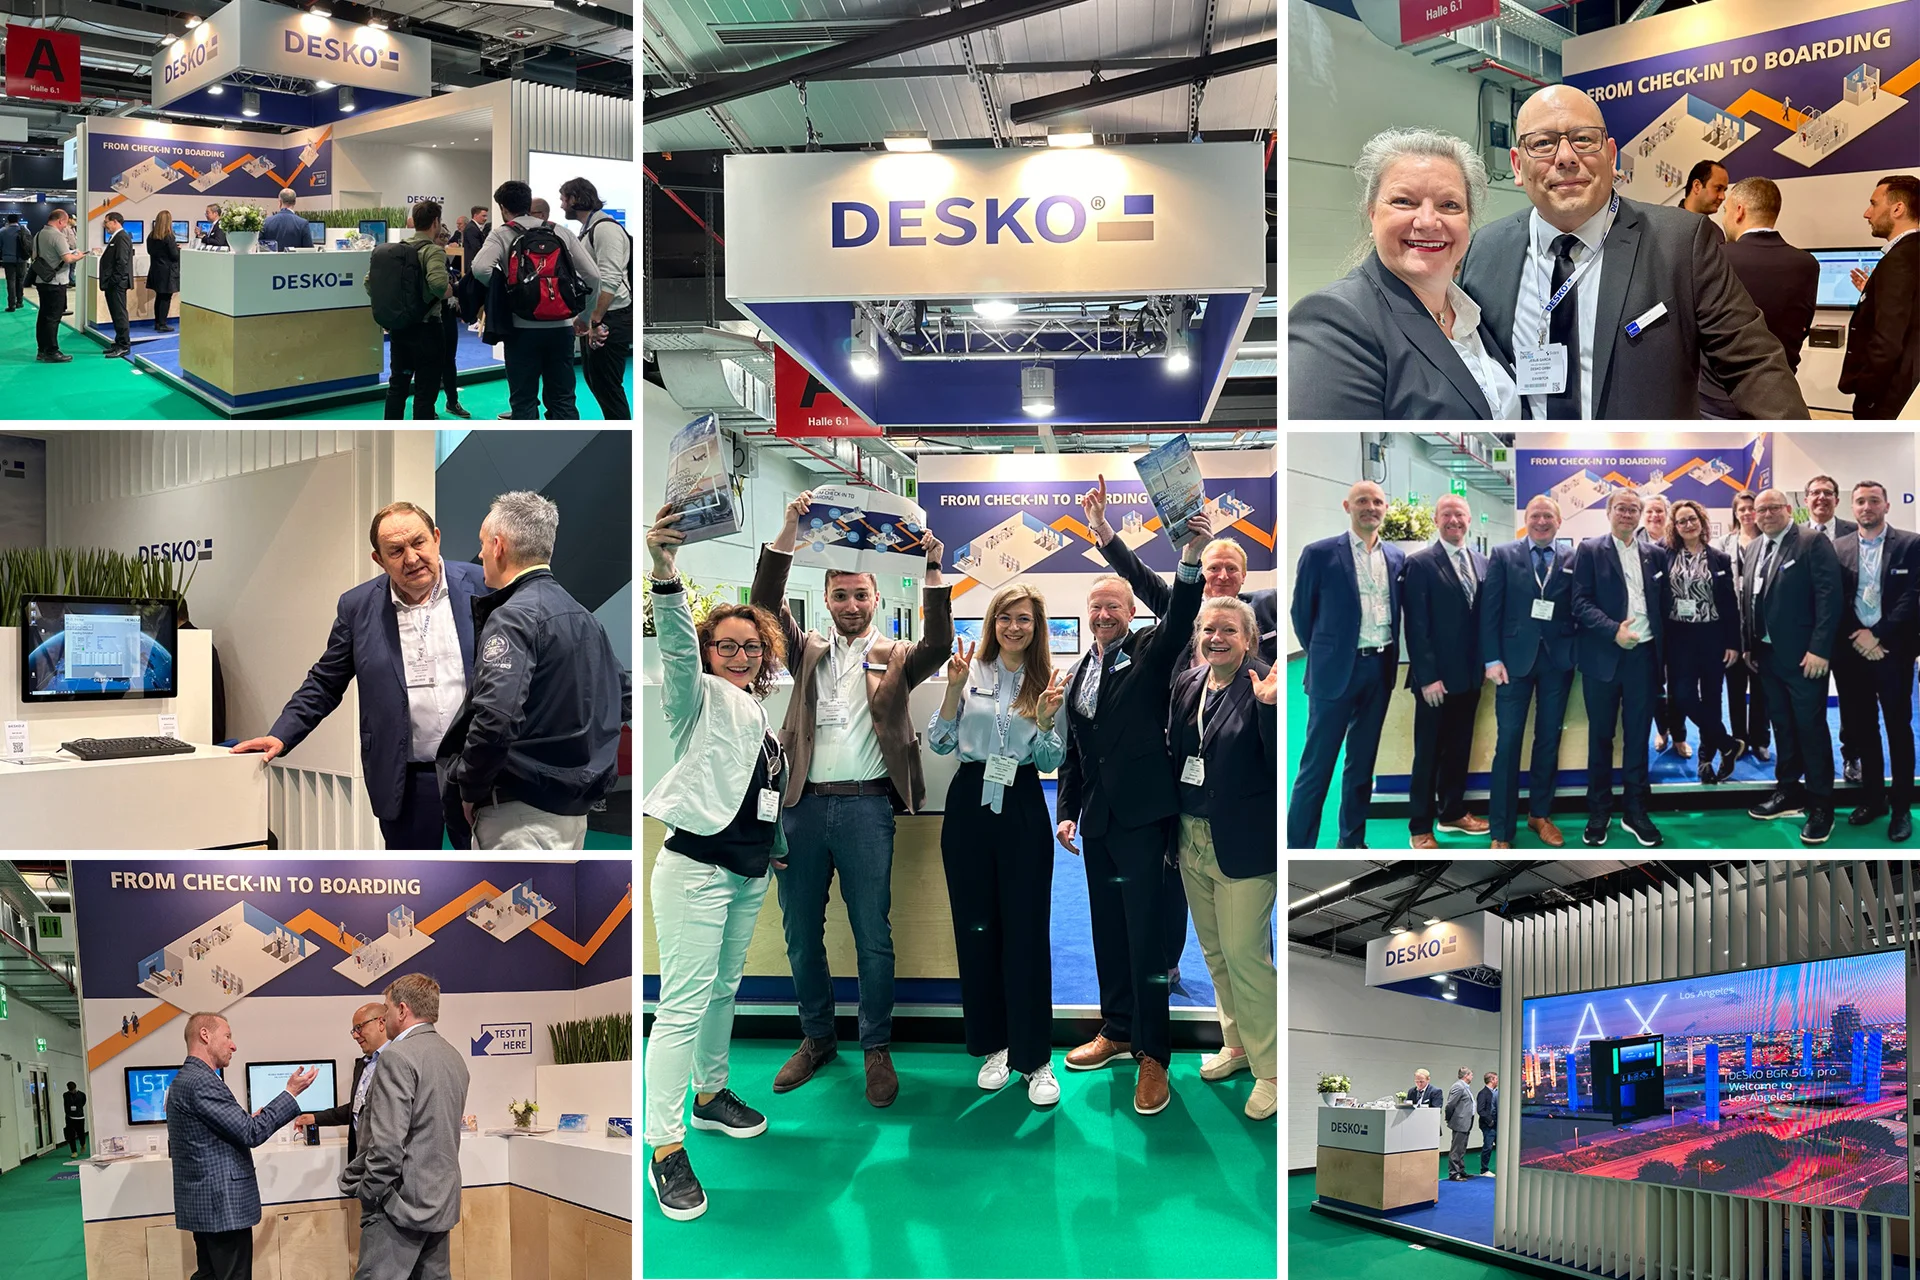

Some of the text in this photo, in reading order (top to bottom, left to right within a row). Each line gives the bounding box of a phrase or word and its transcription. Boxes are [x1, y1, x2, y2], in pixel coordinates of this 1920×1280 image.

[1426, 0, 1463, 21] Halle 6.1
[25, 38, 64, 82] A
[1587, 28, 1891, 103] FROM CHECK-IN TO BOARDING
[30, 84, 60, 94] Halle 6.1
[103, 142, 225, 158] FROM CHECK-IN TO BOARDING
[808, 417, 849, 426] Halle 6.1
[1530, 457, 1667, 465] FROM CHECK-IN TO BOARDING
[940, 492, 1148, 506] FROM CHECK-IN TO BRDING
[110, 872, 421, 895] FROM CHECK-IN TO BOARDING
[1679, 986, 1735, 1000] Los Angeles
[495, 1028, 526, 1038] TEST IT
[503, 1040, 526, 1050] HERE
[1729, 1069, 1763, 1081] DESKO
[1766, 1068, 1788, 1079] BGR
[1817, 1068, 1837, 1078] pro
[135, 1074, 169, 1092] IST
[1729, 1081, 1793, 1091] Welcome to
[1729, 1092, 1795, 1104] Los Angeles!
